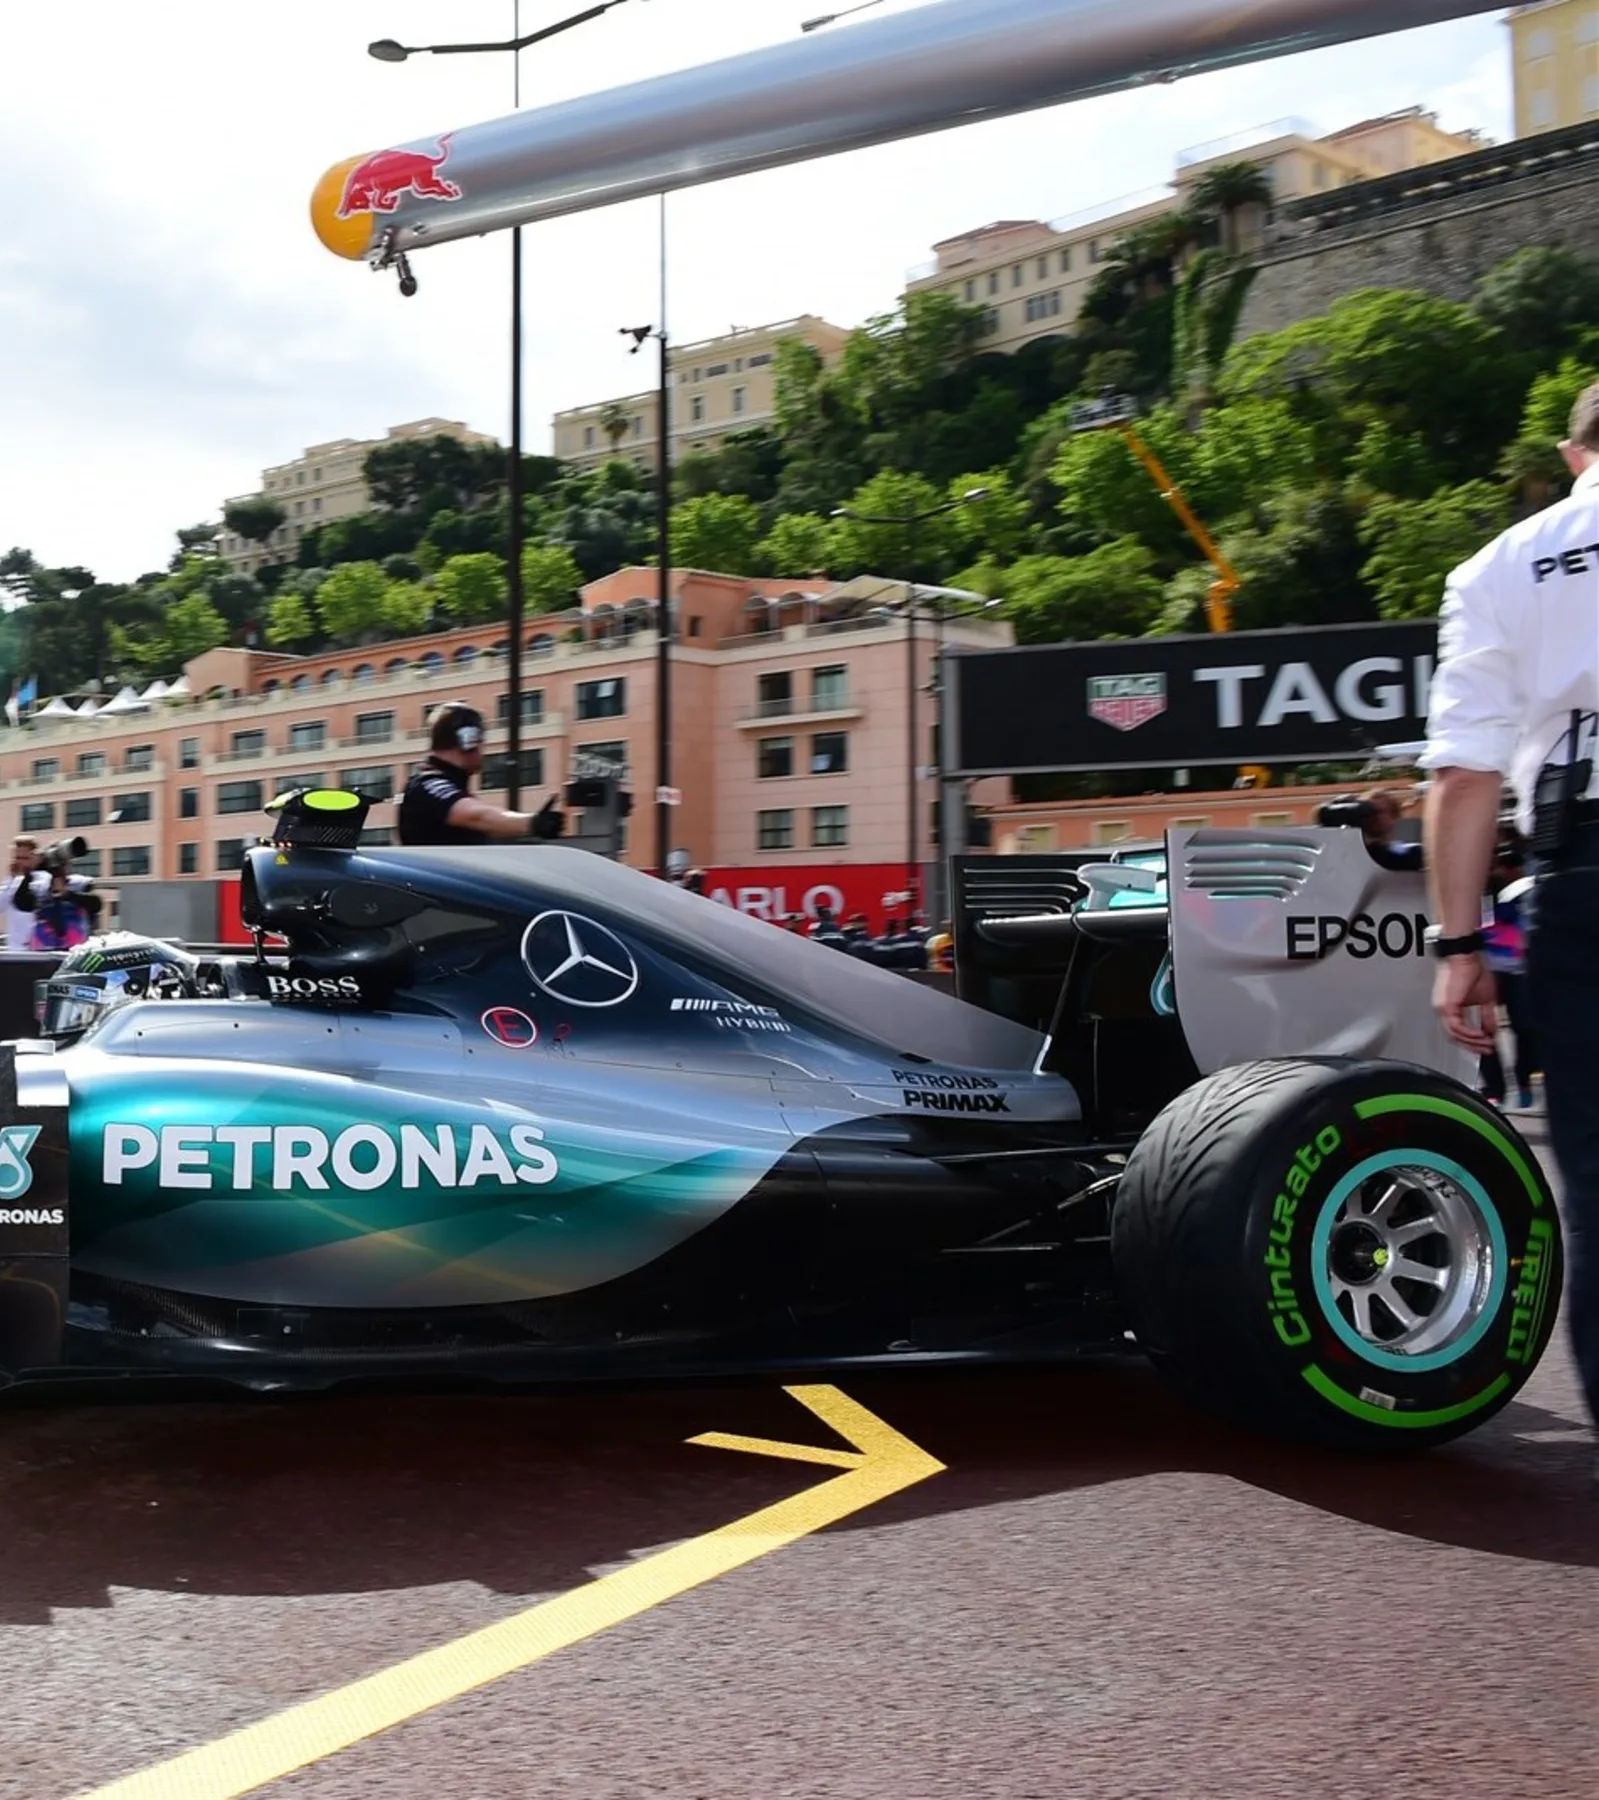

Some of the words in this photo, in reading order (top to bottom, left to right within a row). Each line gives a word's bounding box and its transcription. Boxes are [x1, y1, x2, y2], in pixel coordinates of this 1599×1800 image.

[266, 976, 360, 994] BOSS
[711, 1000, 780, 1017] AMG
[892, 1069, 998, 1089] PETRONAS
[903, 1089, 1012, 1112] PRIMAX
[103, 1123, 559, 1190] PETRONAS
[1263, 1125, 1343, 1348] Cinturato
[1504, 1216, 1556, 1366] PIRELLI
